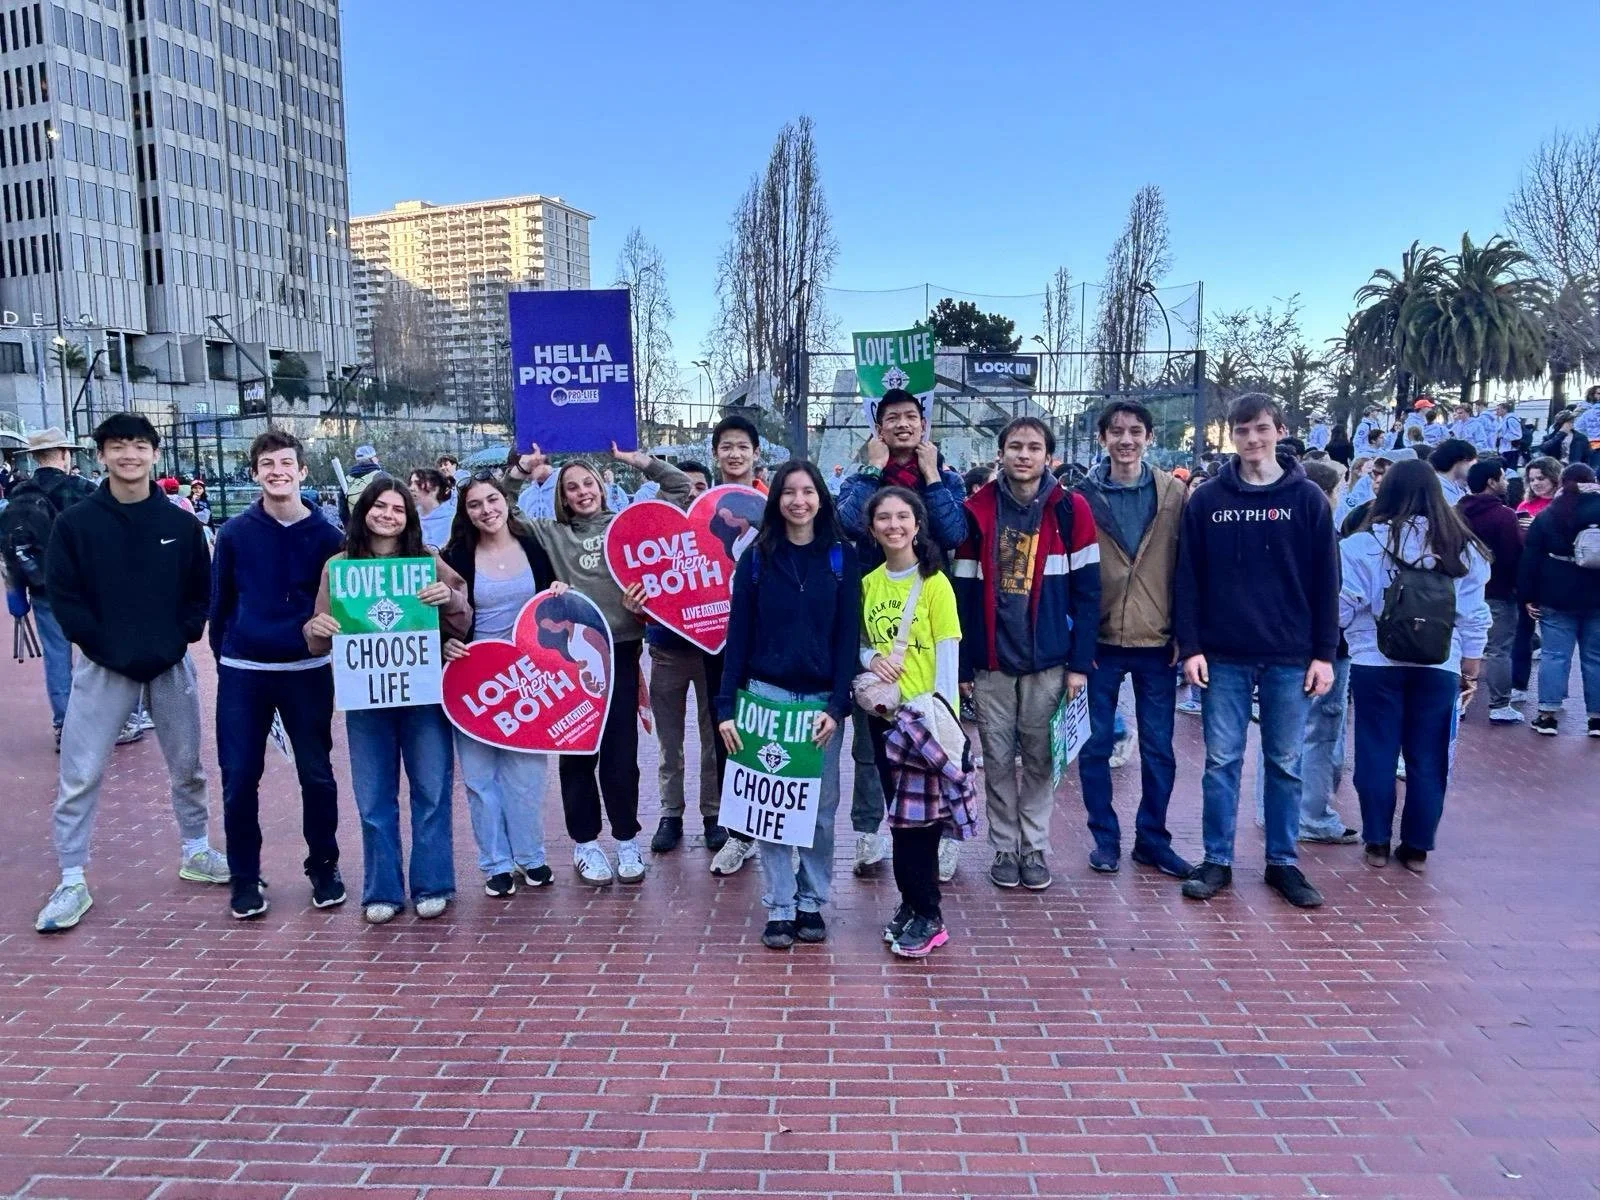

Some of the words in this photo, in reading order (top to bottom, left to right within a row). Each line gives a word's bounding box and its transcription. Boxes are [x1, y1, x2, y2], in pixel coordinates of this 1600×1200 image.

[534, 344, 612, 364] HELLA
[856, 337, 895, 366] LOVE
[899, 332, 932, 364] LIFE
[519, 364, 629, 385] PRO-LIFE
[974, 362, 1014, 374] LOCK
[1015, 362, 1031, 376] IN
[1212, 508, 1291, 522] GRYPHON
[623, 531, 699, 569] LOVE
[658, 550, 710, 574] them
[335, 566, 386, 599] LOVE
[391, 563, 432, 597] LIFE
[641, 560, 723, 598] BOTH
[868, 602, 886, 622] WALK
[346, 635, 429, 671] CHOOSE
[368, 671, 411, 704] LIFE
[462, 654, 541, 717] LOVE
[503, 669, 556, 701] them
[492, 669, 576, 738] BOTH
[736, 697, 781, 742] LOVE
[733, 768, 809, 811] CHOOSE
[746, 805, 786, 840] LIFE
